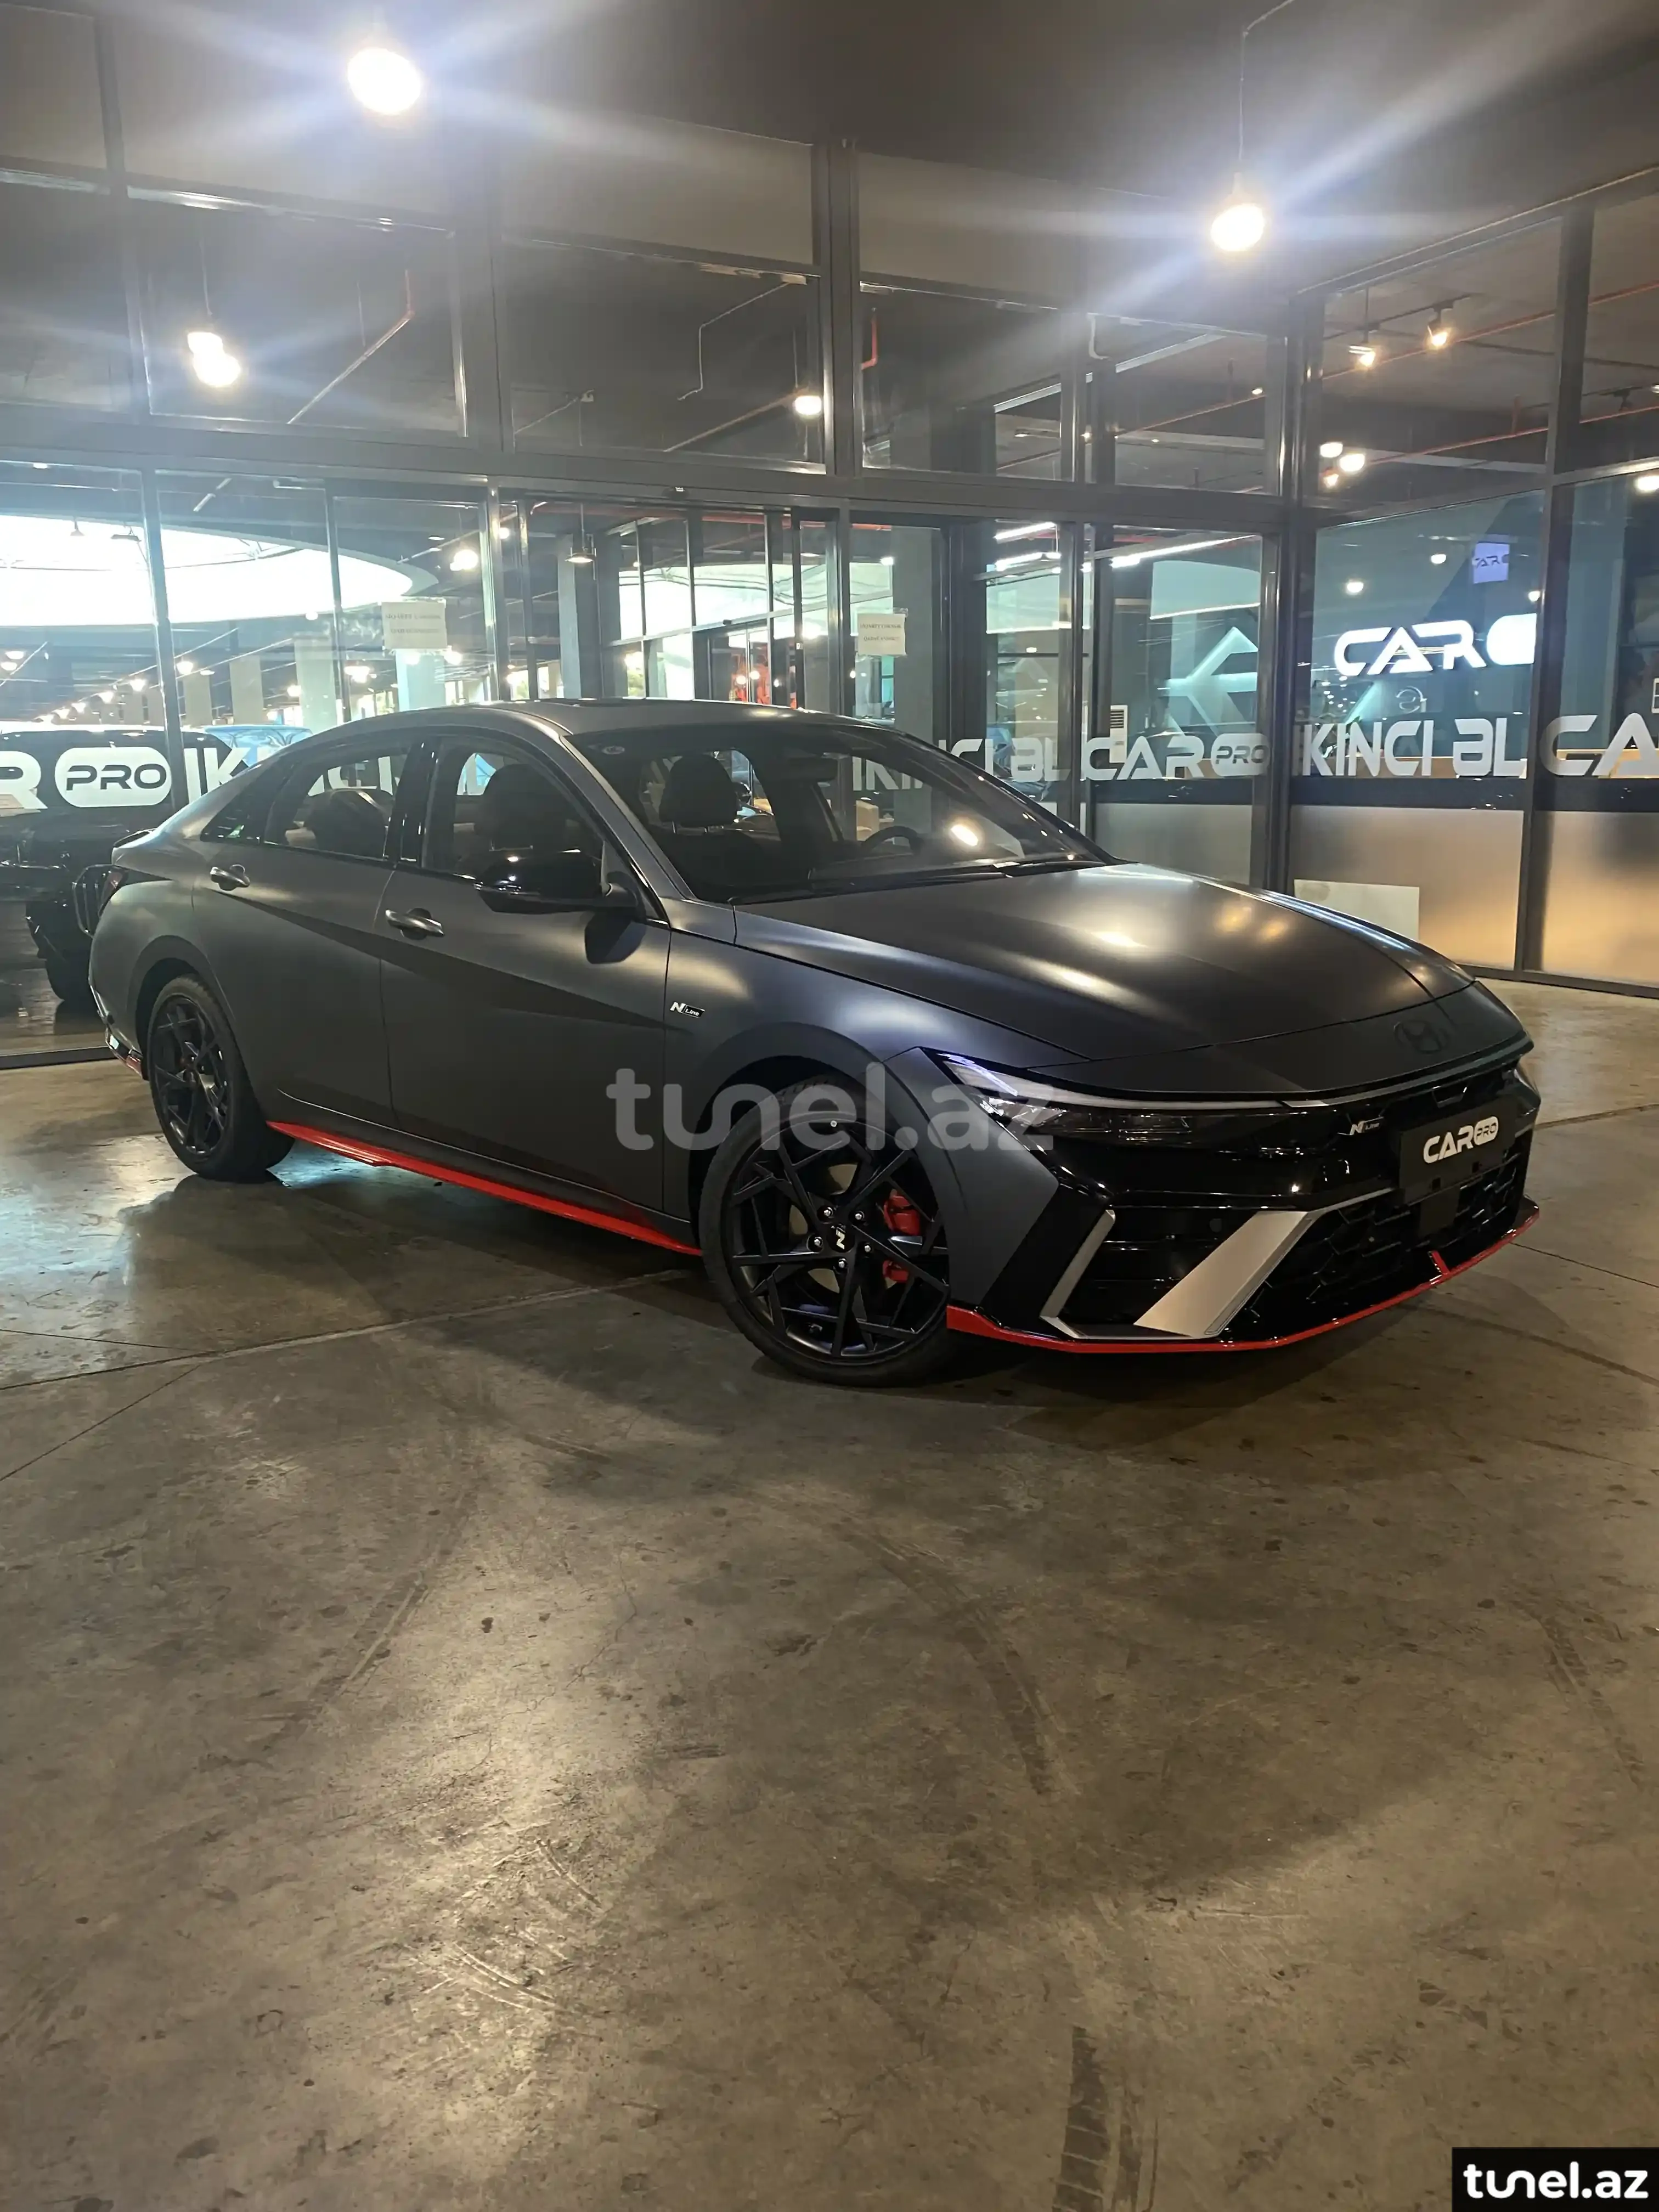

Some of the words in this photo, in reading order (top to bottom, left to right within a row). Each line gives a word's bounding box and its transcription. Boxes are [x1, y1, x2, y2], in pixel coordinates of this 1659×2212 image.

[1334, 619, 1487, 676] CAR
[66, 763, 167, 791] PRO
[1081, 736, 1205, 781] CAR
[1215, 744, 1269, 765] PRO
[670, 1002, 686, 1013] N
[1423, 1125, 1474, 1164] CAR
[1476, 1122, 1497, 1140] PRO
